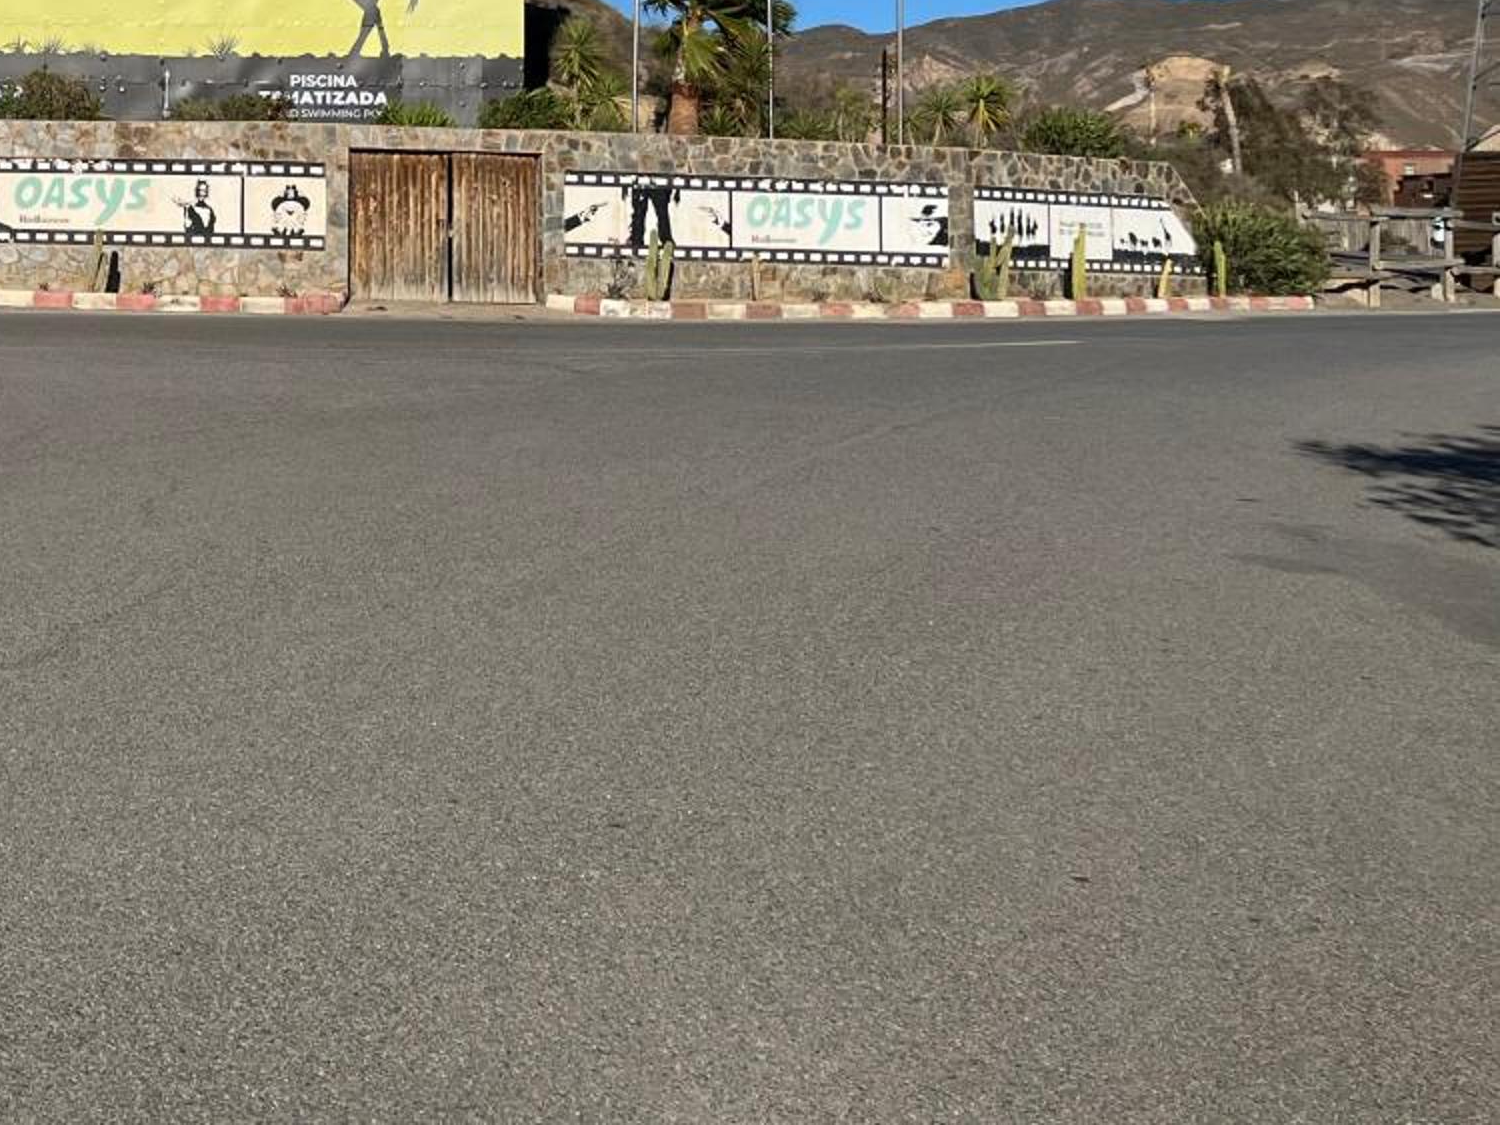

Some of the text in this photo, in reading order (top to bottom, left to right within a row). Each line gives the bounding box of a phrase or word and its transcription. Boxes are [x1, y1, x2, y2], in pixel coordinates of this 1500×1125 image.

[289, 74, 358, 88] PISCINA
[301, 108, 361, 119] SWIMMING
[14, 175, 154, 226] OASYS
[746, 194, 867, 245] OASYS
